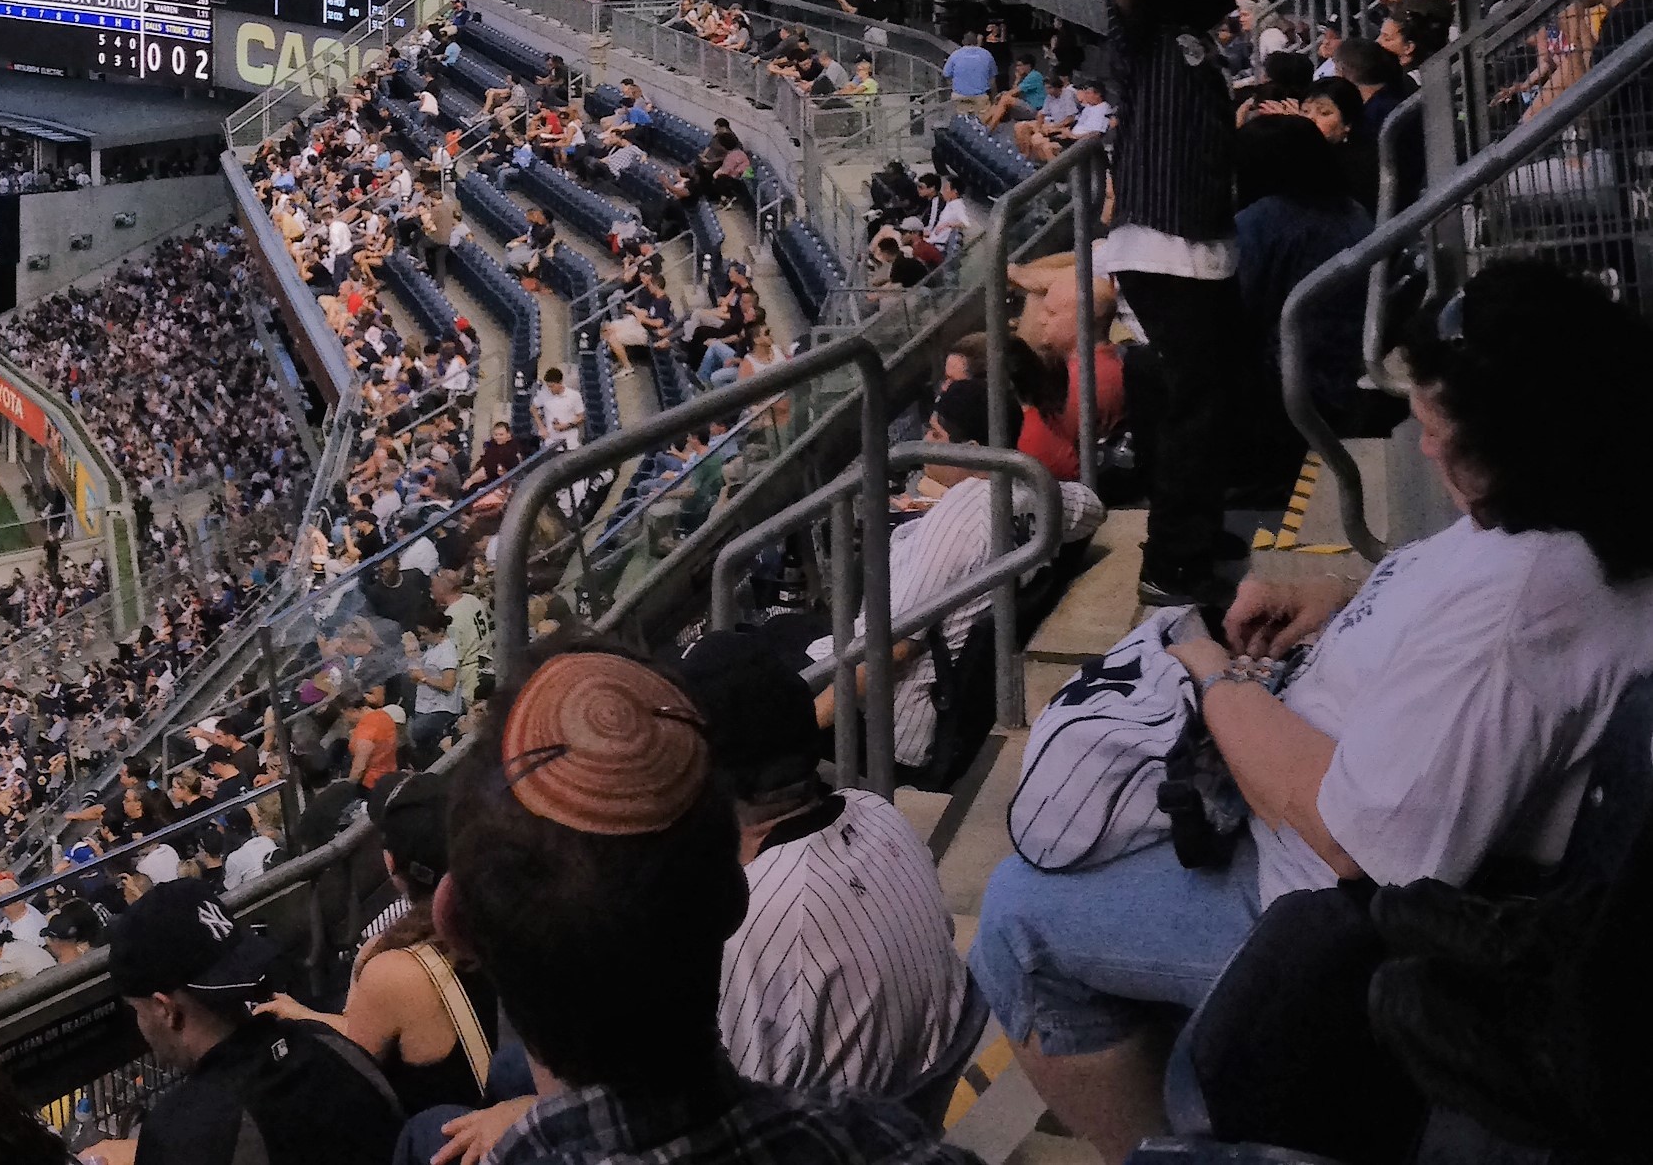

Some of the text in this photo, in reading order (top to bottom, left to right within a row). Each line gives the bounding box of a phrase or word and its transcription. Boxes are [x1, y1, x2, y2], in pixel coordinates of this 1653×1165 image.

[99, 34, 106, 46] 5
[114, 36, 121, 48] 4
[130, 38, 136, 50] 0
[98, 52, 105, 65] 0
[114, 54, 121, 67] 3
[147, 42, 209, 80] 0 0 2
[197, 900, 234, 941] NY
